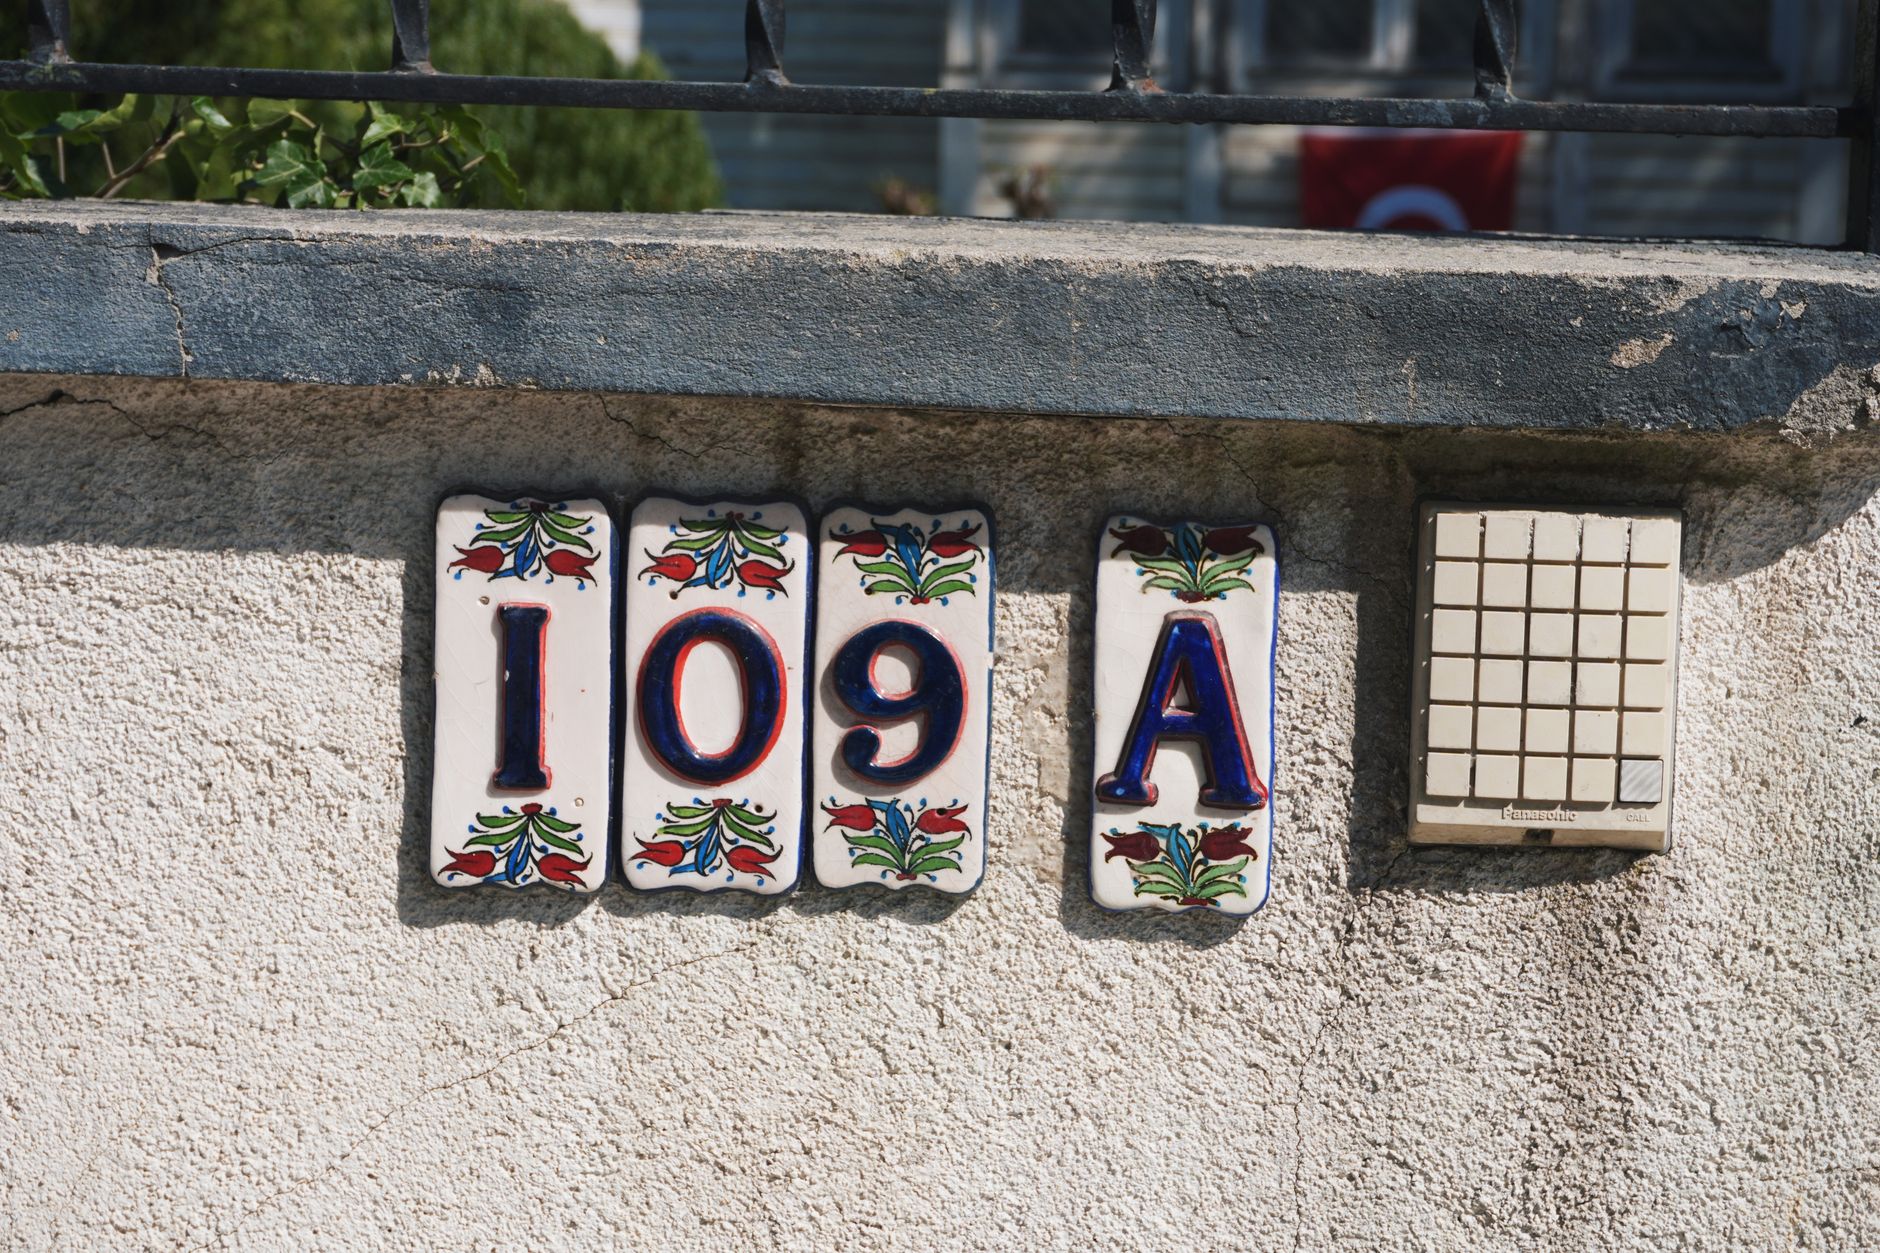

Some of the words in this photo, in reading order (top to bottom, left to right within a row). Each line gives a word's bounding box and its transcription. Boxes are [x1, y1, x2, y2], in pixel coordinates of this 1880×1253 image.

[1095, 610, 1267, 809] A
[1502, 808, 1577, 822] Panasonic
[1626, 812, 1651, 822] CALL
